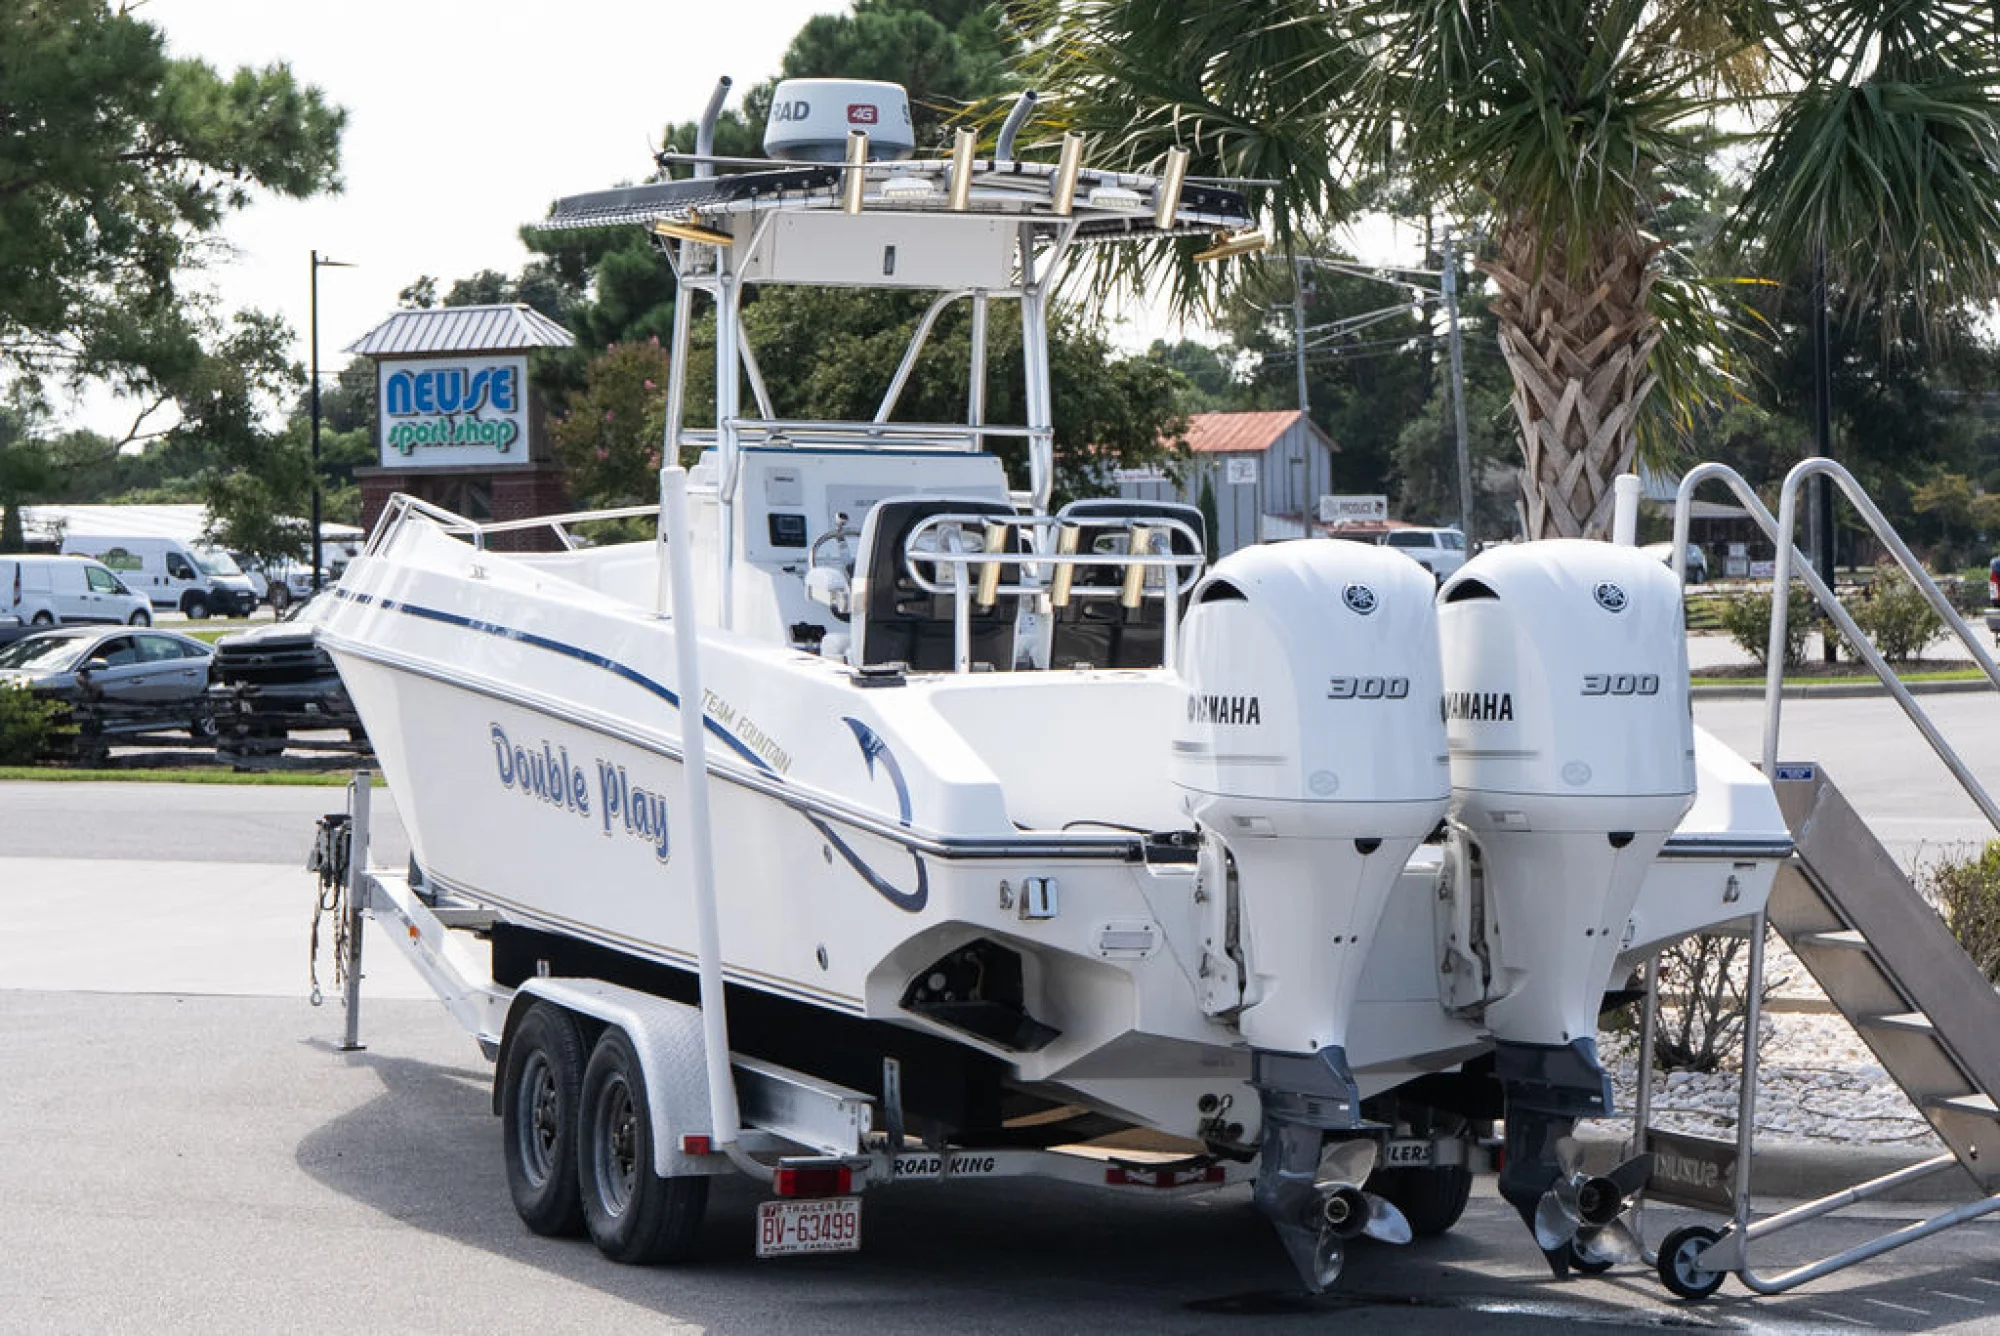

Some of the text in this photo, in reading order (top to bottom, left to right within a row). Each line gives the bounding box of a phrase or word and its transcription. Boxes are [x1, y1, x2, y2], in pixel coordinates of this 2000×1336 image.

[851, 107, 874, 121] 4G
[387, 366, 518, 417] NEUSE
[388, 415, 518, 456] sport shop
[1328, 675, 1410, 700] 300
[1580, 673, 1660, 696] 300
[1196, 695, 1261, 725] YAMAHA
[1446, 692, 1514, 722] YAMAHA
[489, 722, 670, 865] Double Play
[893, 1157, 994, 1174] ROAD KING
[762, 1212, 856, 1245] BV-63499
